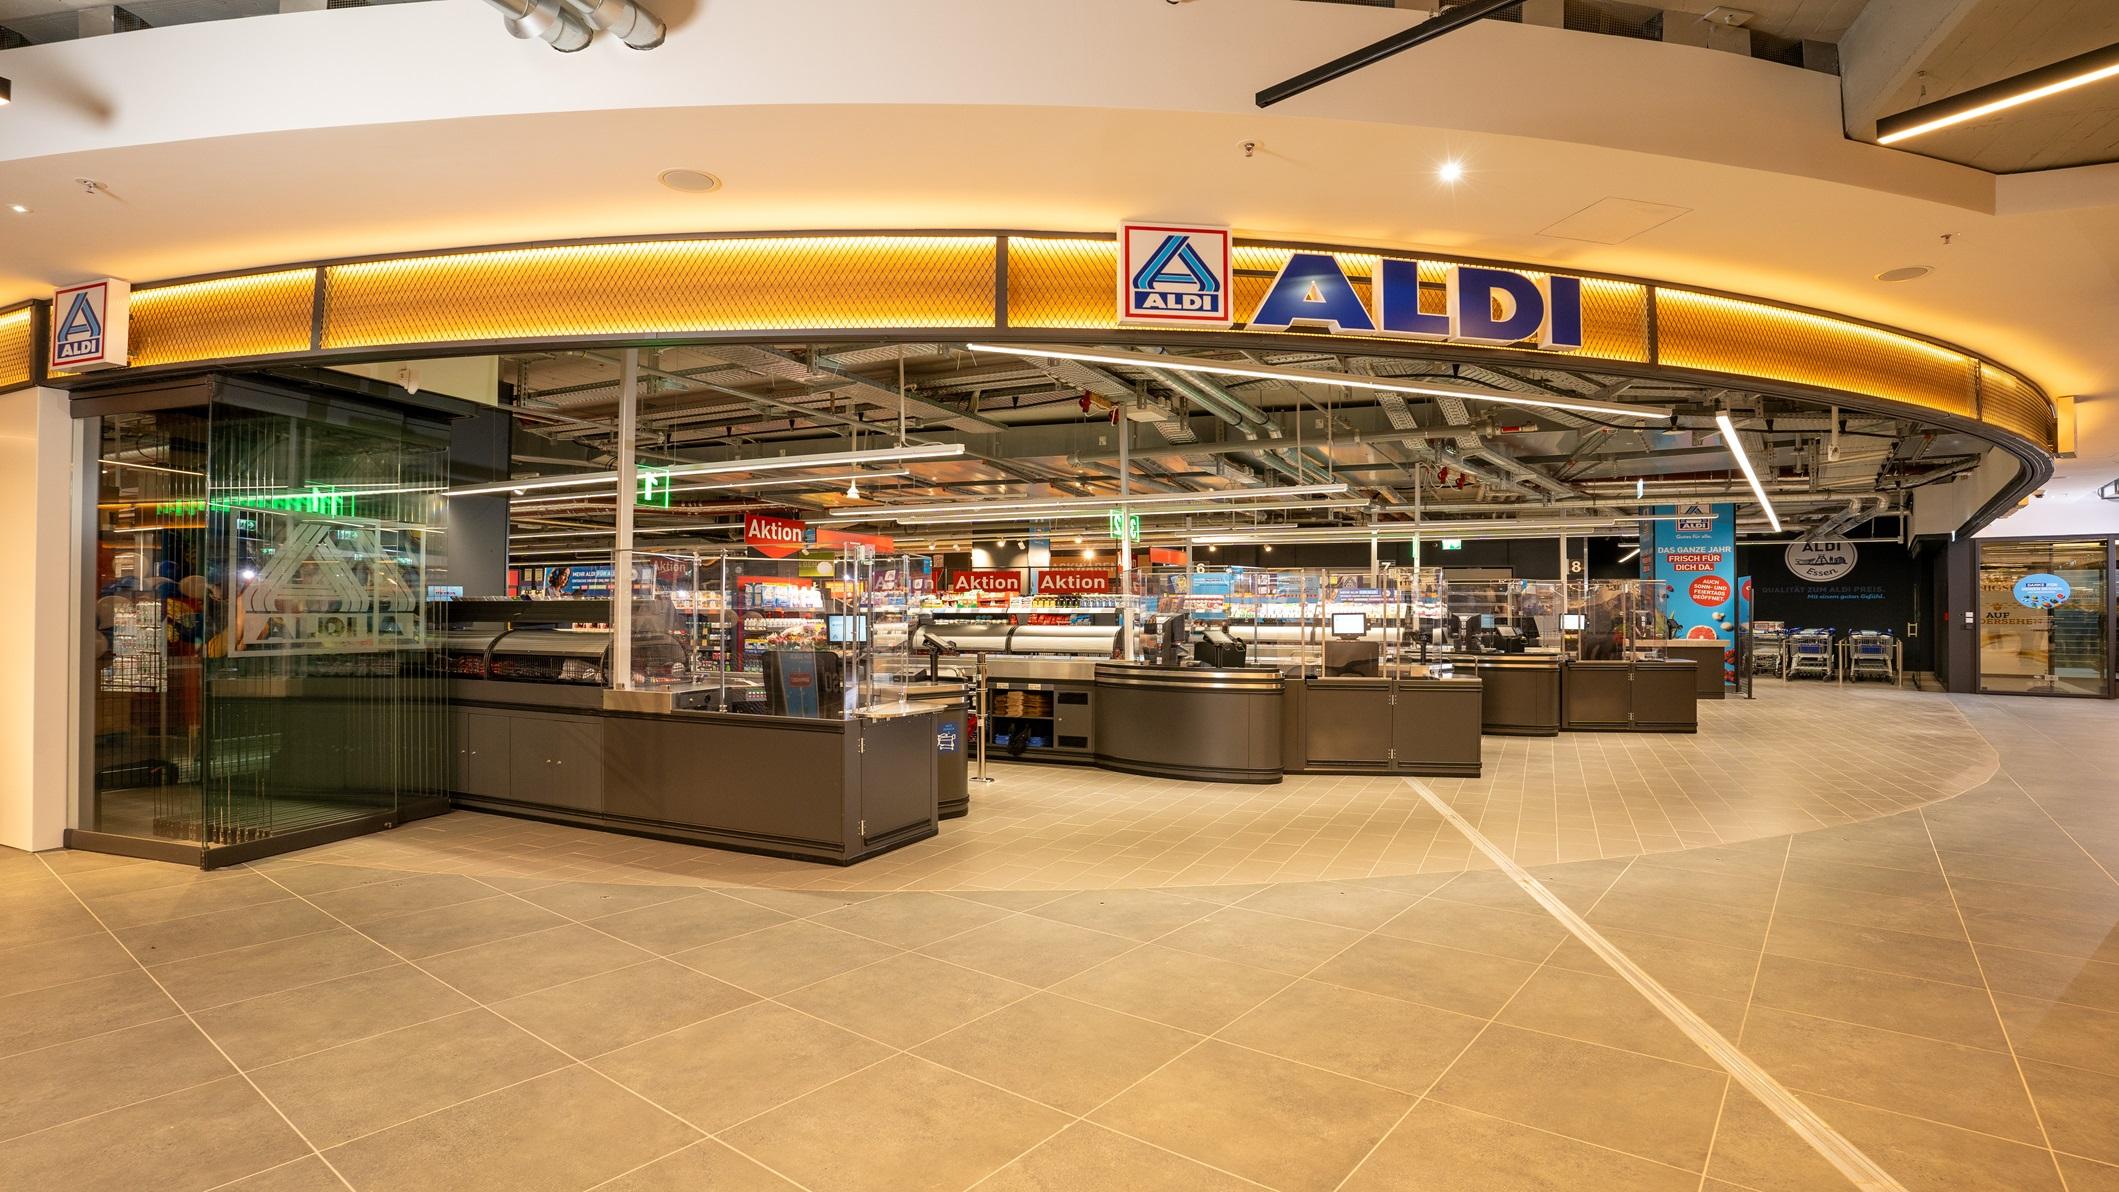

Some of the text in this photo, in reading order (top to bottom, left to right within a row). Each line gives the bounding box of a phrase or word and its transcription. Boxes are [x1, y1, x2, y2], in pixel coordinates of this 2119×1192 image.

[1142, 293, 1211, 311] ALDI
[1247, 253, 1582, 350] ALDI
[61, 340, 97, 357] ALDI
[748, 519, 802, 543] Aktion
[1802, 542, 1841, 552] ALDI
[1702, 553, 1721, 562] FÜR
[1196, 563, 1205, 573] 6
[1571, 561, 1581, 572] 8
[1806, 567, 1839, 577] Essen
[955, 574, 1018, 589] Aktion
[1040, 574, 1105, 589] Aktion
[1762, 585, 1805, 593] QUALITÄT
[1692, 594, 1725, 602] GEÖFFNET.
